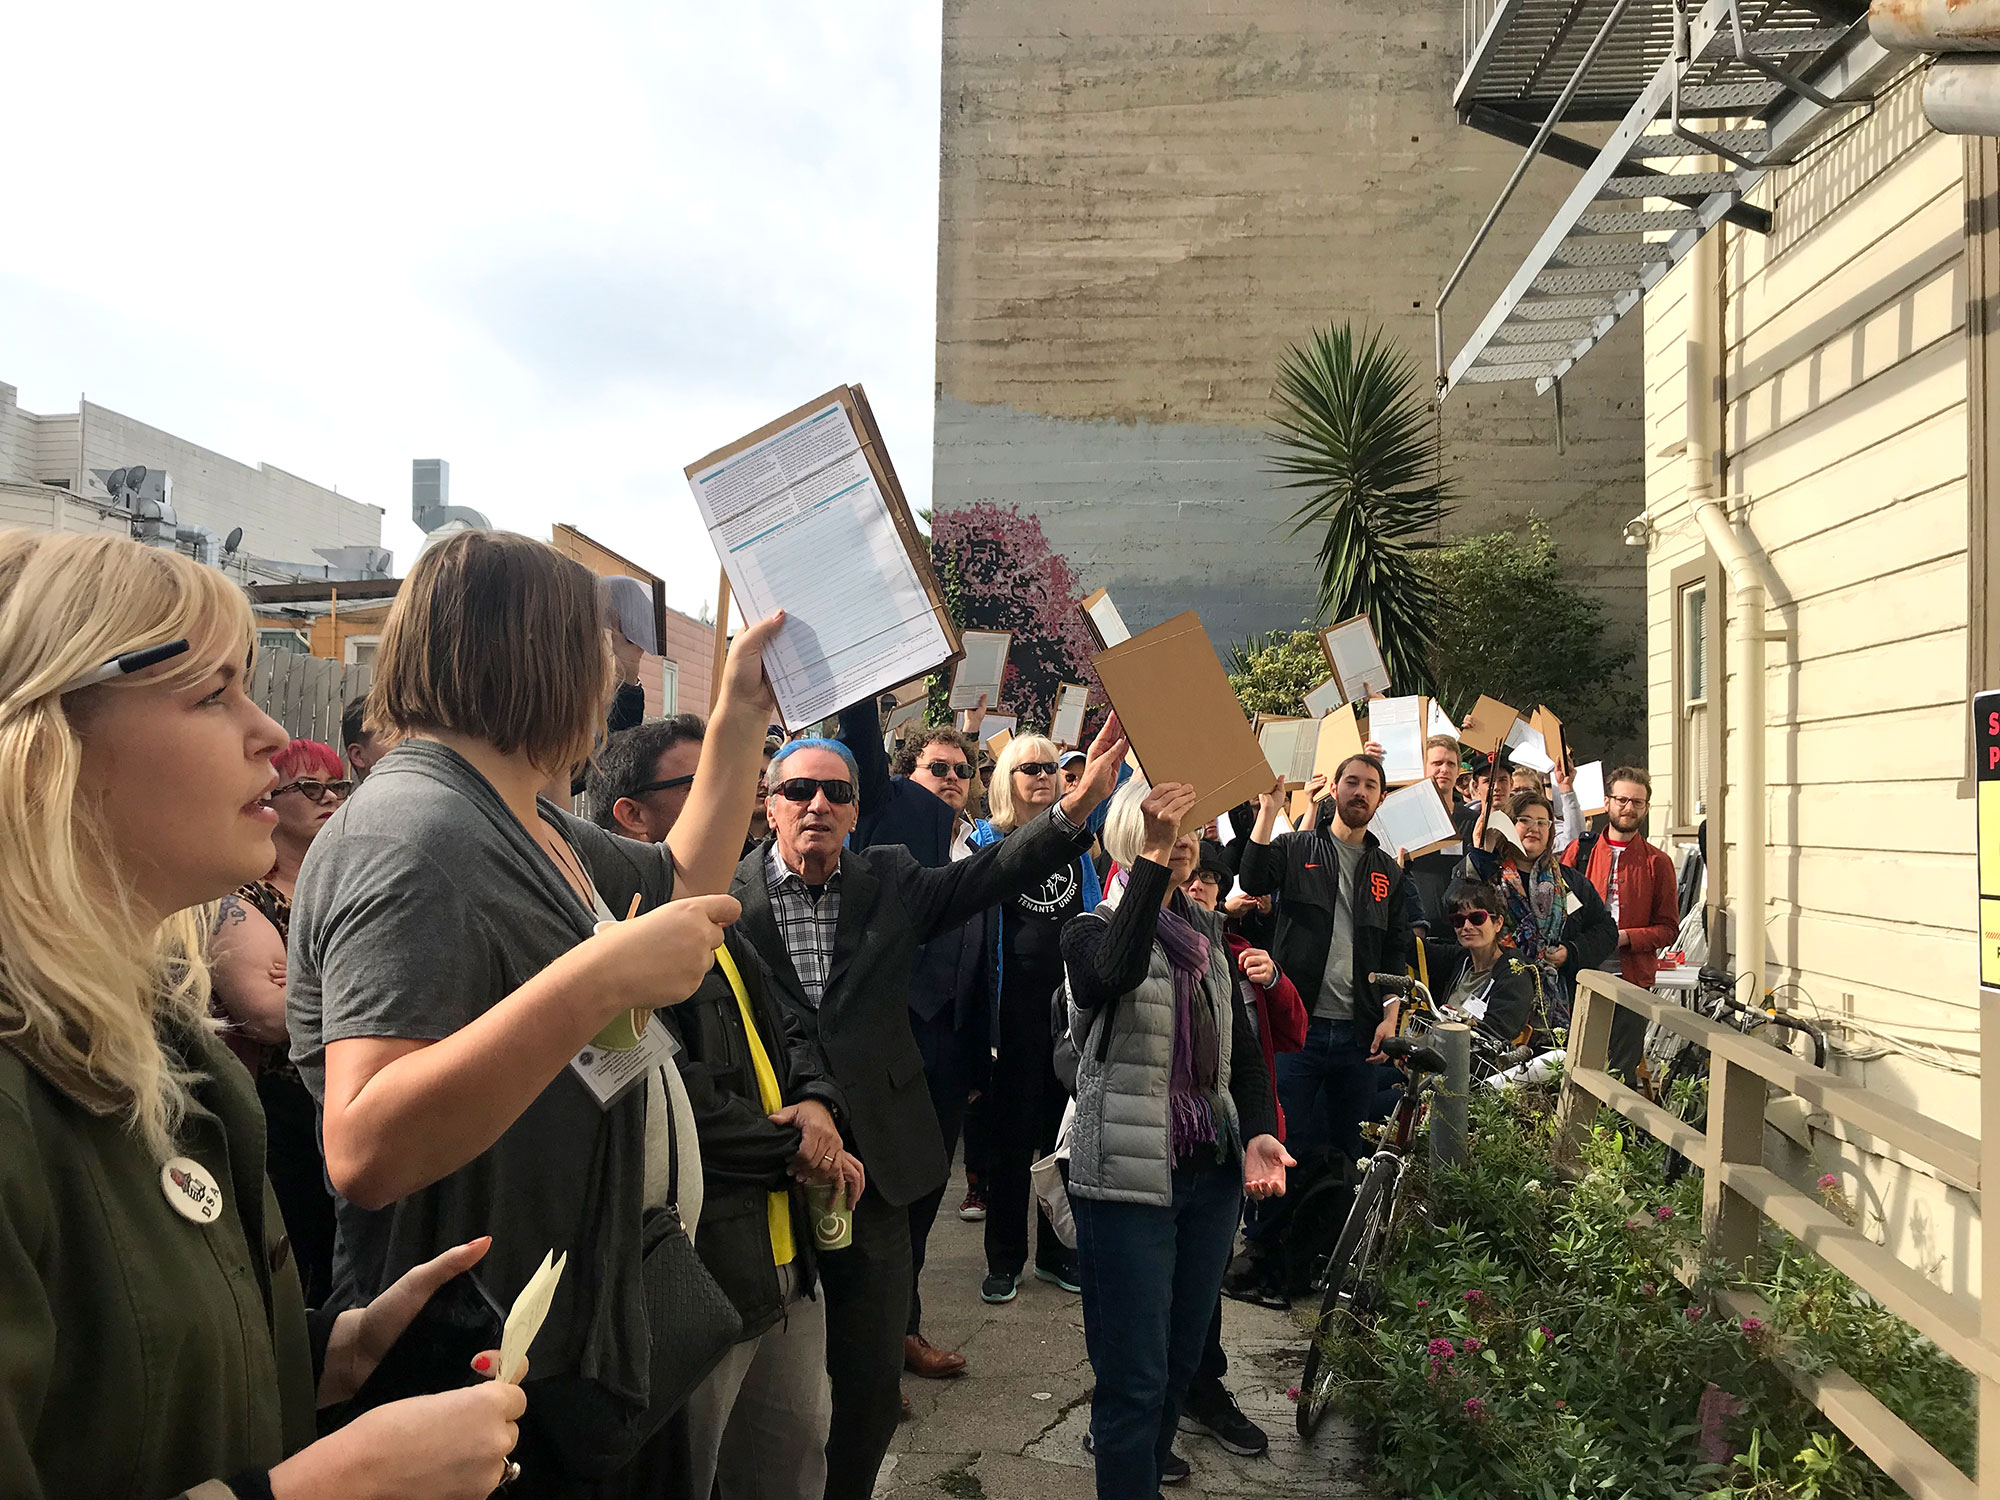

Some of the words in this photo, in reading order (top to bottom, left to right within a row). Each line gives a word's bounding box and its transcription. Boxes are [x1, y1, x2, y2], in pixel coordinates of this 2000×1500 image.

[1017, 896, 1056, 913] TENANTS
[1058, 882, 1078, 908] UNION
[1370, 871, 1391, 902] SF
[201, 1187, 220, 1218] DSA
